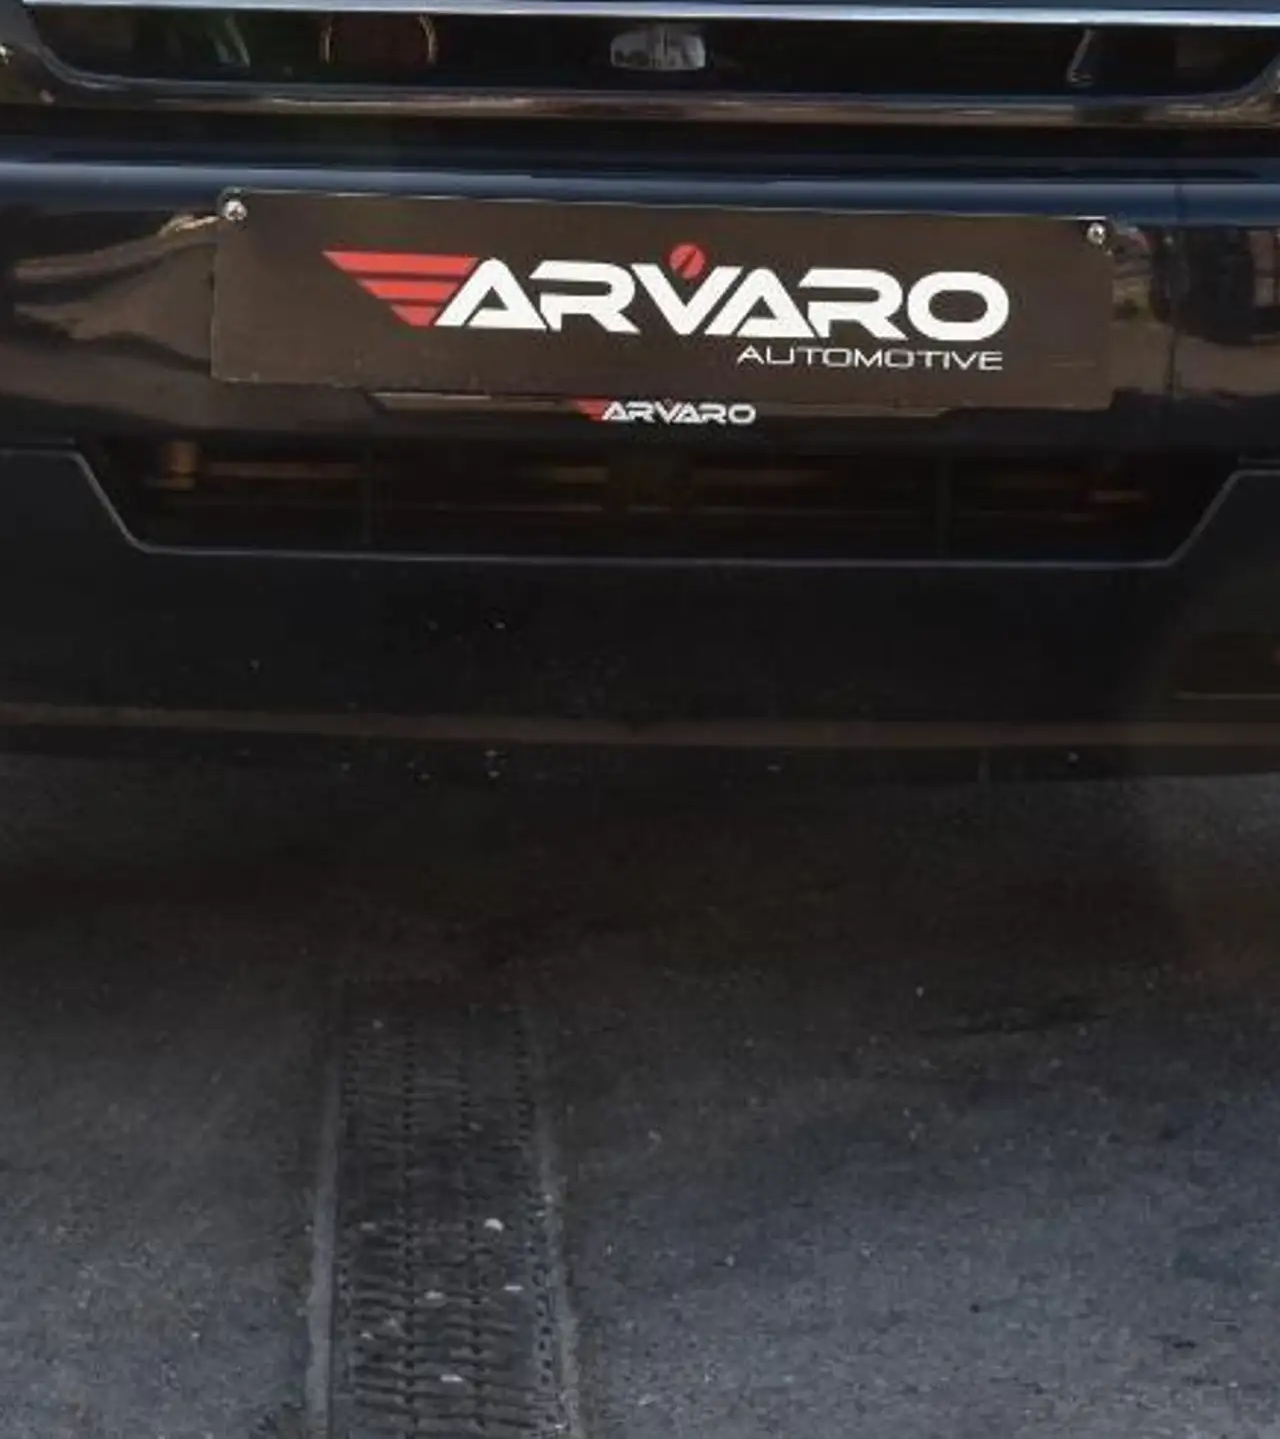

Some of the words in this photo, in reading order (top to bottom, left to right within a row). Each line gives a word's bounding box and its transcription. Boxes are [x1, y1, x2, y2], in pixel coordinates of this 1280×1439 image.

[434, 257, 1010, 341] ARVARO
[736, 344, 1004, 371] AUTOMOTIVE
[601, 400, 757, 425] ARVARO
